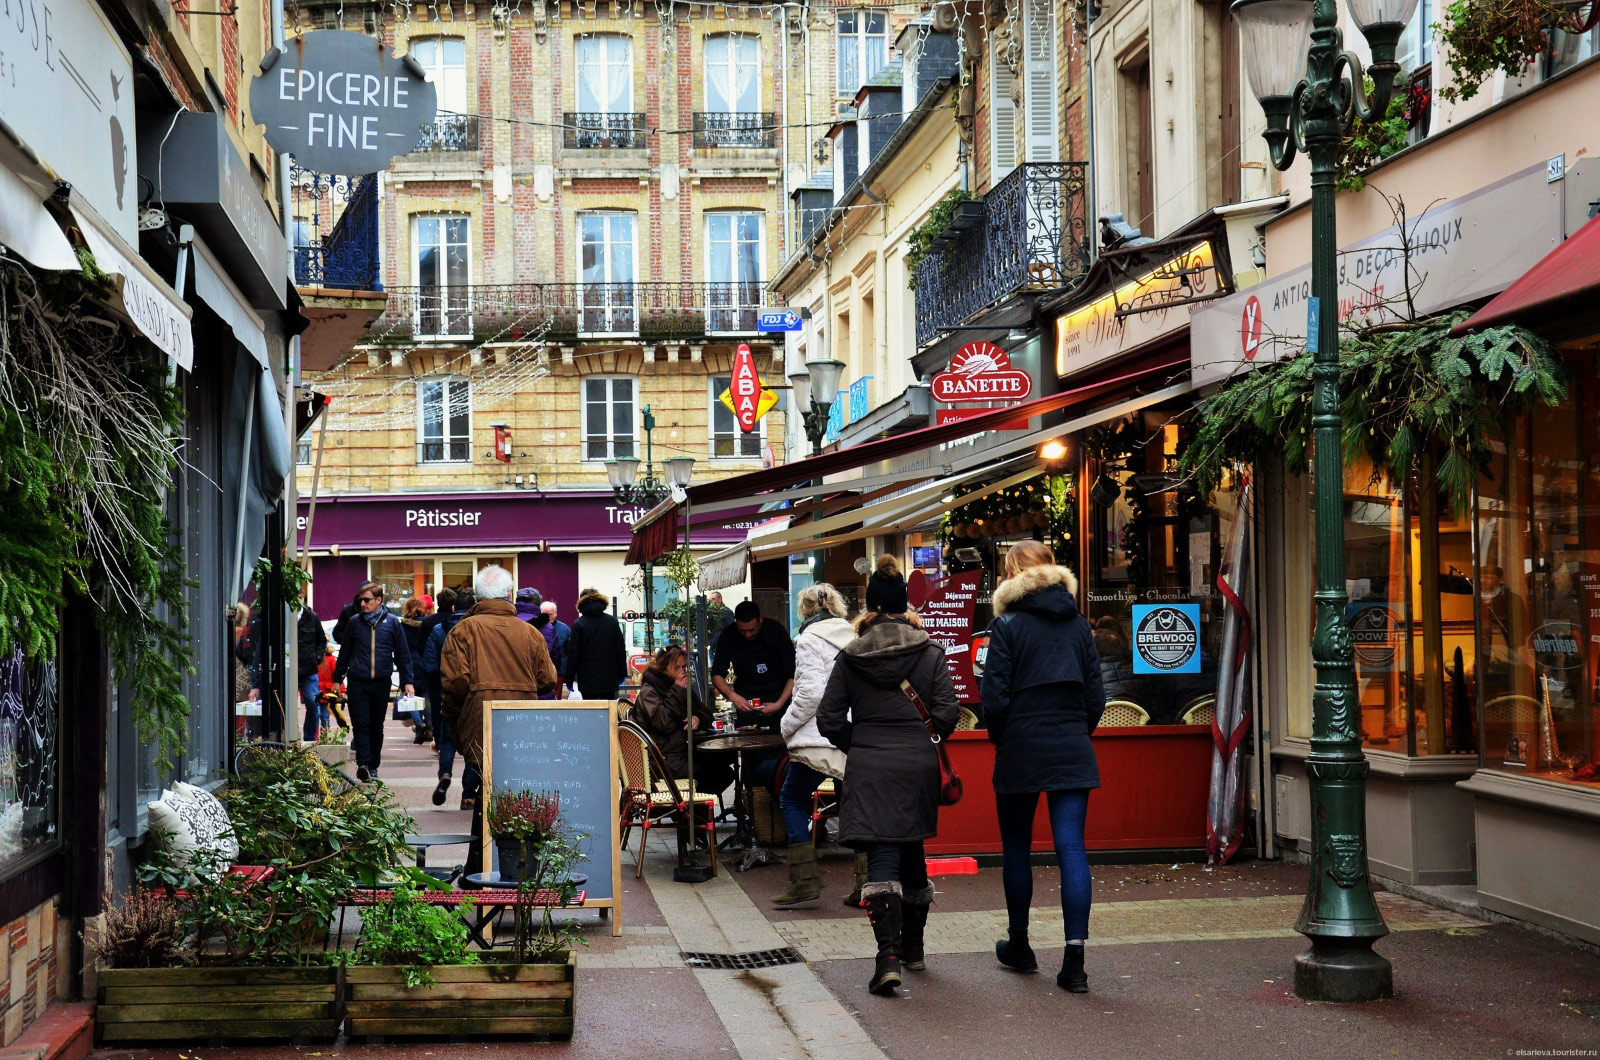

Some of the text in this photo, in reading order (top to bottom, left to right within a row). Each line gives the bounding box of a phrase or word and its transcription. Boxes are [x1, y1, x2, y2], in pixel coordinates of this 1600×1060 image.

[279, 67, 409, 108] EPICERIE
[308, 112, 379, 151] FINE
[1407, 217, 1463, 260] BIJOUX
[1067, 344, 1081, 358] 1991
[738, 350, 755, 425] TABAC
[941, 378, 1021, 394] BANETTE
[405, 508, 482, 527] Pâtissier
[961, 583, 976, 591] Petit
[945, 592, 972, 601] Déjeuner
[1087, 590, 1138, 602] Smoothies
[1146, 589, 1192, 600] Chocolat
[936, 617, 969, 628] MAISON
[1138, 633, 1195, 643] BREWDOG
[535, 714, 552, 722] NEW
[556, 741, 592, 753] SAUVAGE
